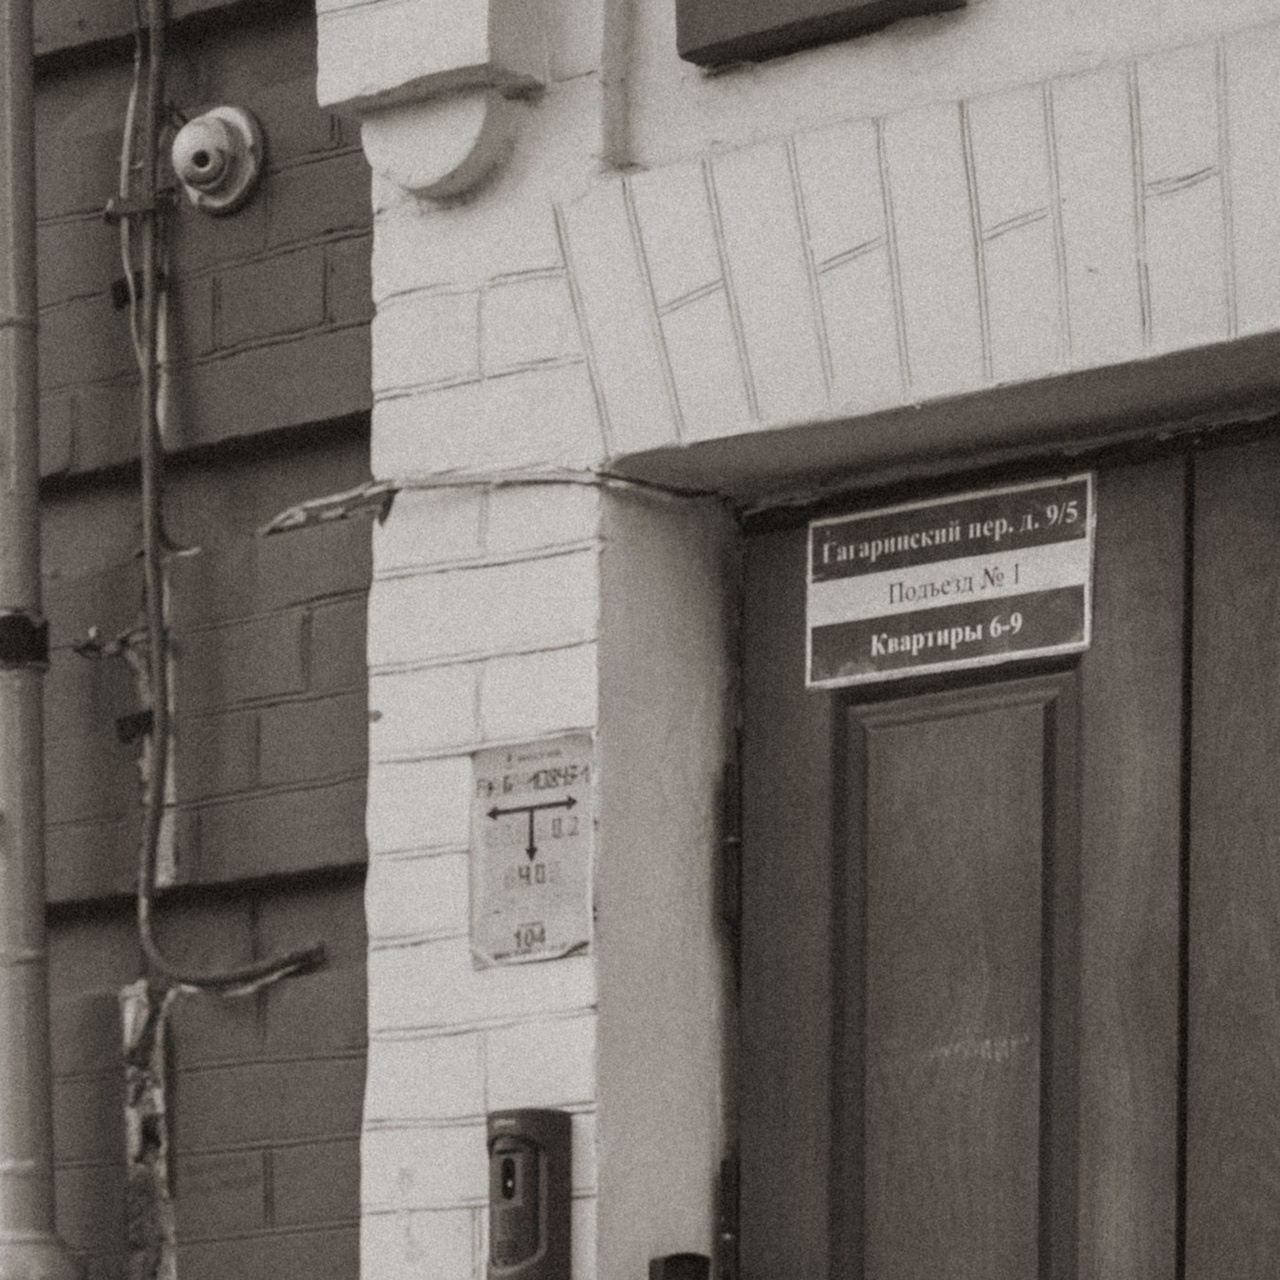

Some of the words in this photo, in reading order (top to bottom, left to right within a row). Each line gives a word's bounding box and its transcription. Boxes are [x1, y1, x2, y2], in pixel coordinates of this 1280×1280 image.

[822, 520, 961, 564] Гагаринский
[968, 518, 1014, 541] пер.
[1019, 514, 1039, 532] д.
[1046, 500, 1078, 526] 9/5
[888, 576, 974, 604] Подъезд
[1014, 563, 1020, 585] 1
[870, 624, 983, 657] Квартиры
[989, 612, 1023, 638] 6-9
